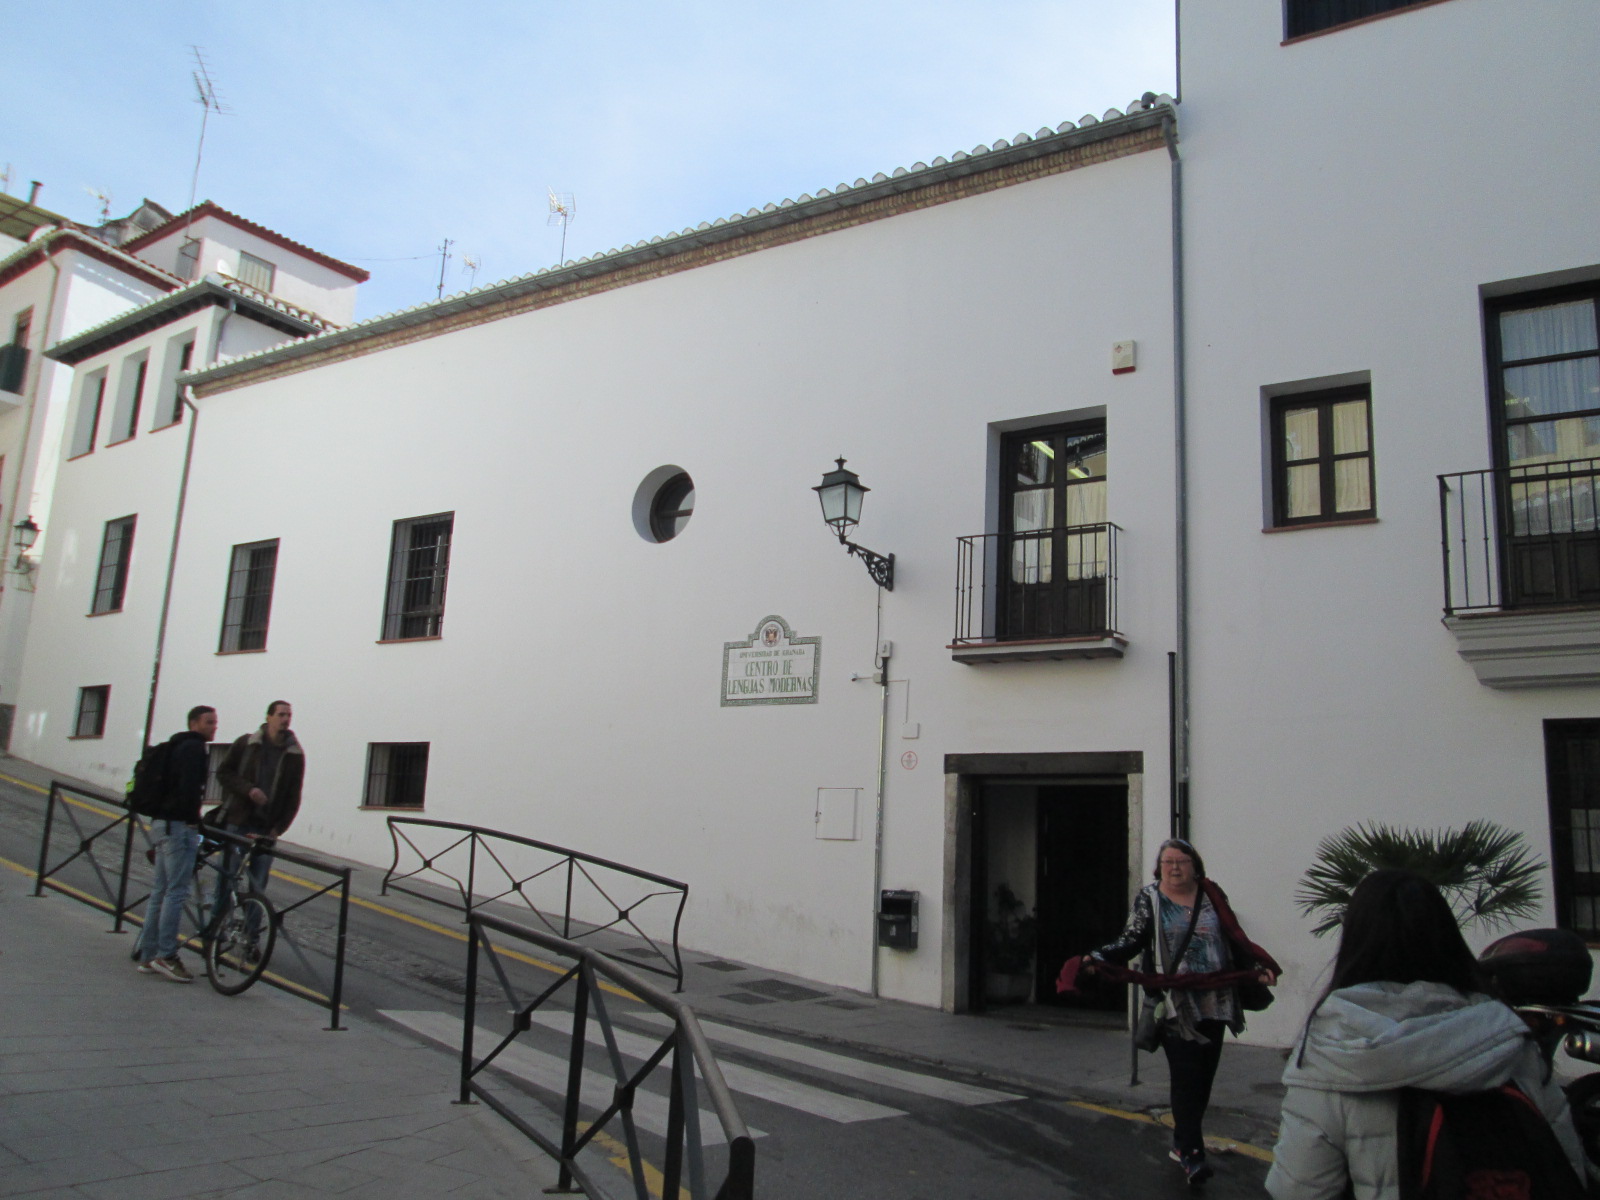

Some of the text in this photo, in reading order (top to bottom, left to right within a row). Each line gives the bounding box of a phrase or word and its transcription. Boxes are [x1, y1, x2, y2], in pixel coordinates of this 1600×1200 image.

[773, 649, 780, 657] DE
[782, 648, 805, 656] GRANADA
[745, 659, 793, 677] CENTRO DE
[728, 676, 813, 695] LENGUAS MODERNAS
